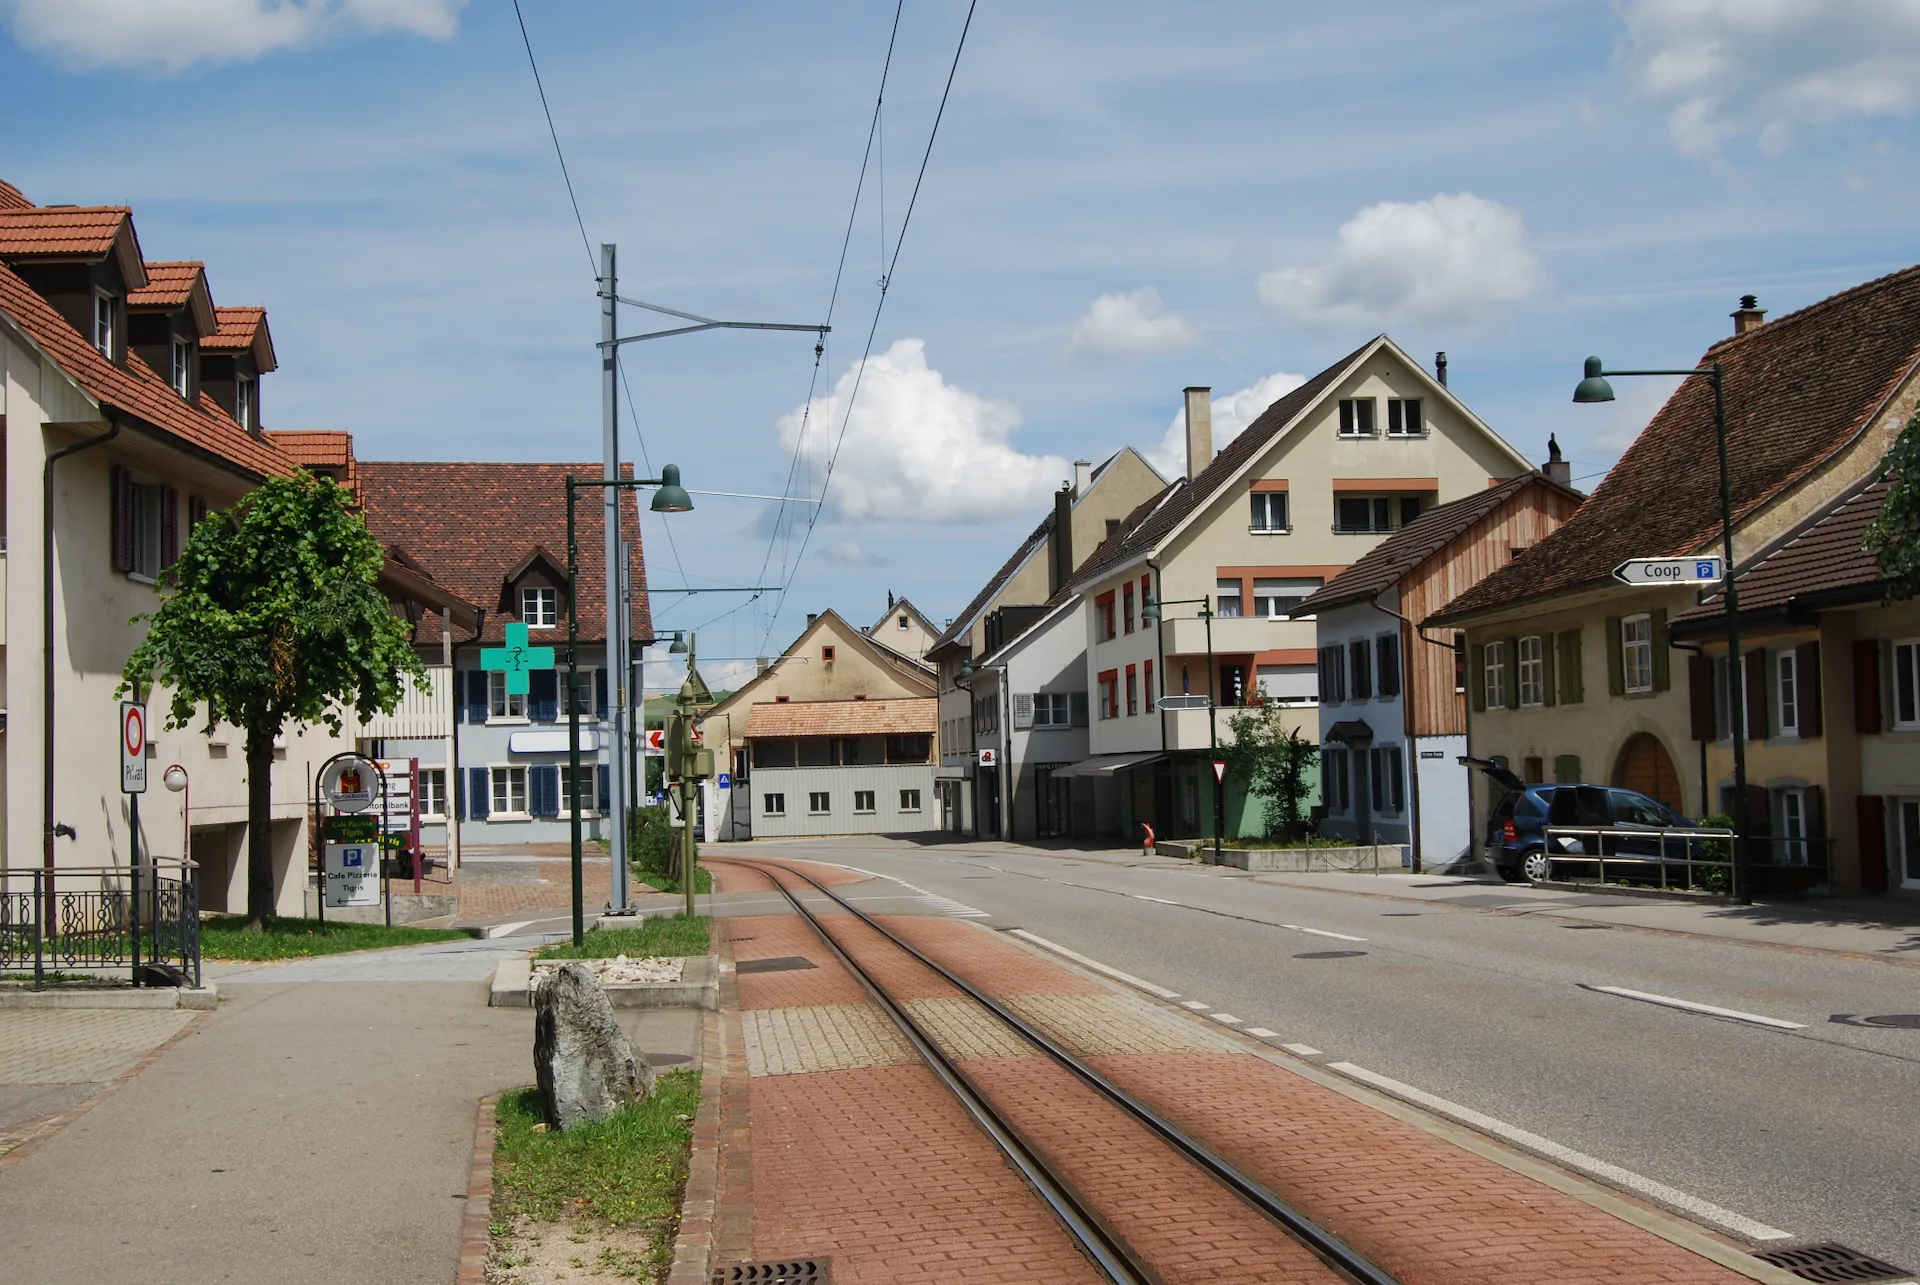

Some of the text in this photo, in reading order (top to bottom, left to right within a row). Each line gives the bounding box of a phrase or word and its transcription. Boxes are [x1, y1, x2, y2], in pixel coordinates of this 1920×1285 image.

[1644, 564, 1681, 580] Coop
[342, 828, 364, 837] Tigris
[347, 871, 378, 879] Pizzeria
[342, 884, 364, 892] Tigris
